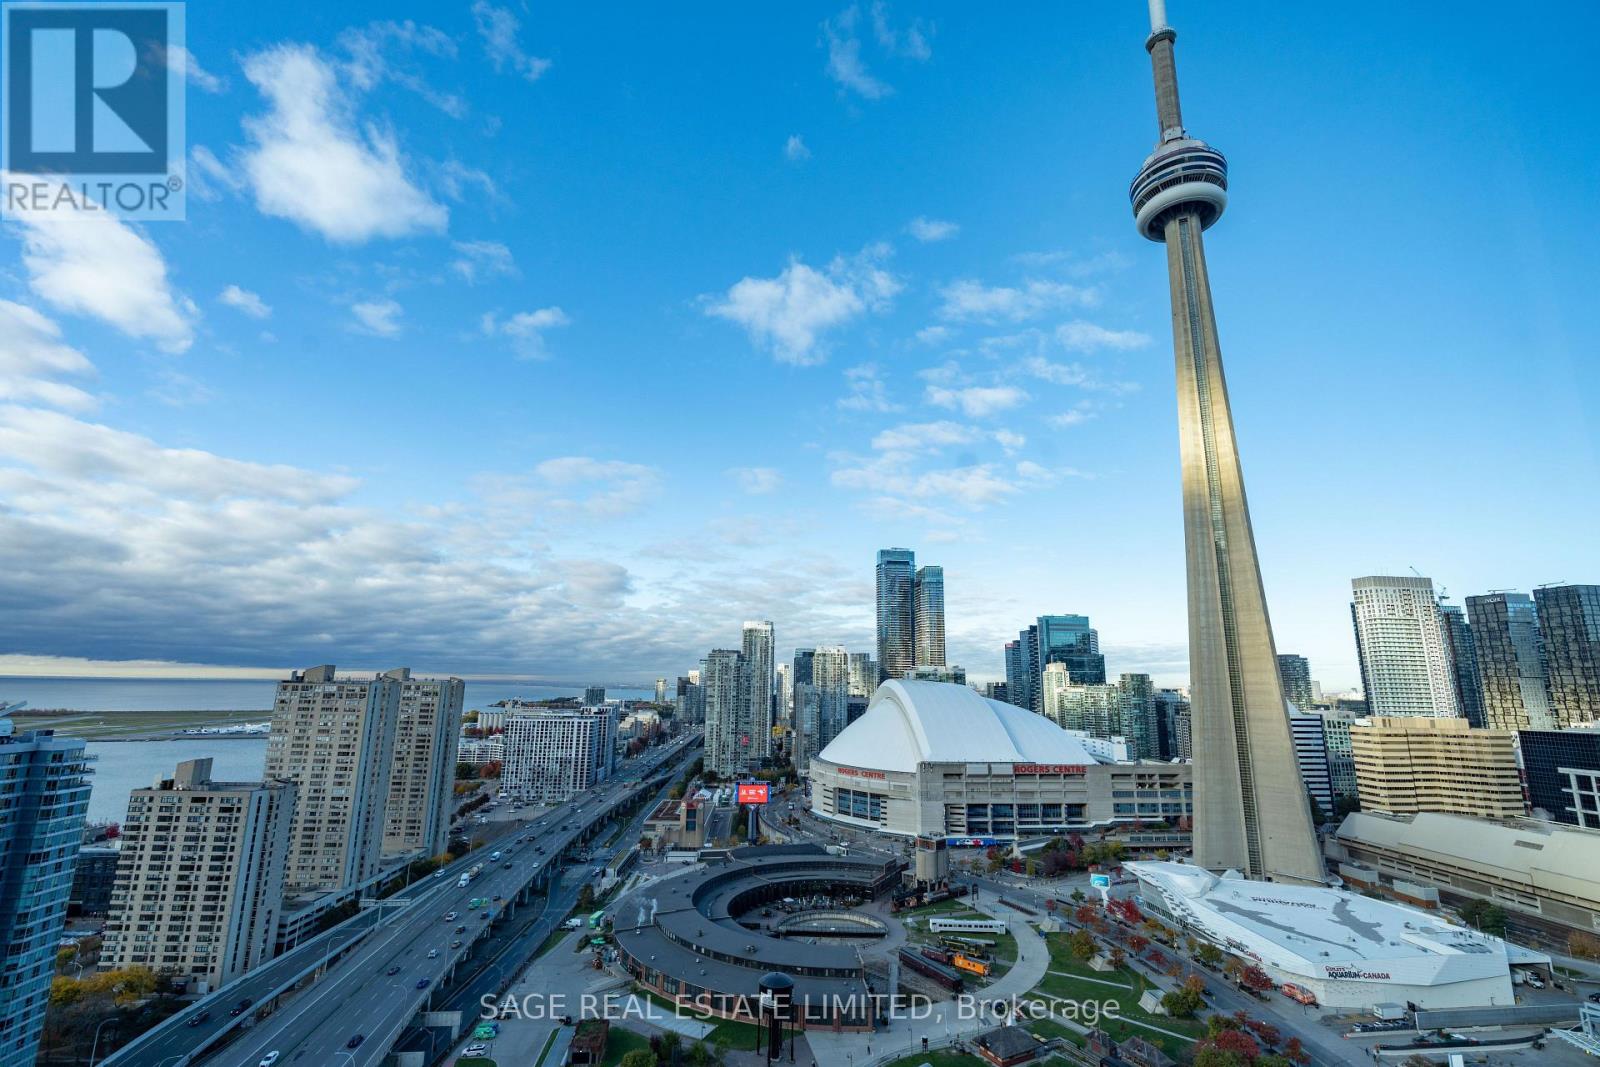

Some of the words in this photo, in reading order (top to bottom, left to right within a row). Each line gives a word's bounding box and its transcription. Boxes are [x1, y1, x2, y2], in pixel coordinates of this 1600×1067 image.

[1014, 765, 1050, 774] ROGERS
[1053, 765, 1087, 774] CENTRE
[861, 770, 886, 780] CENTRE
[1328, 971, 1361, 979] AQUARIUM
[1363, 972, 1391, 980] CANADA
